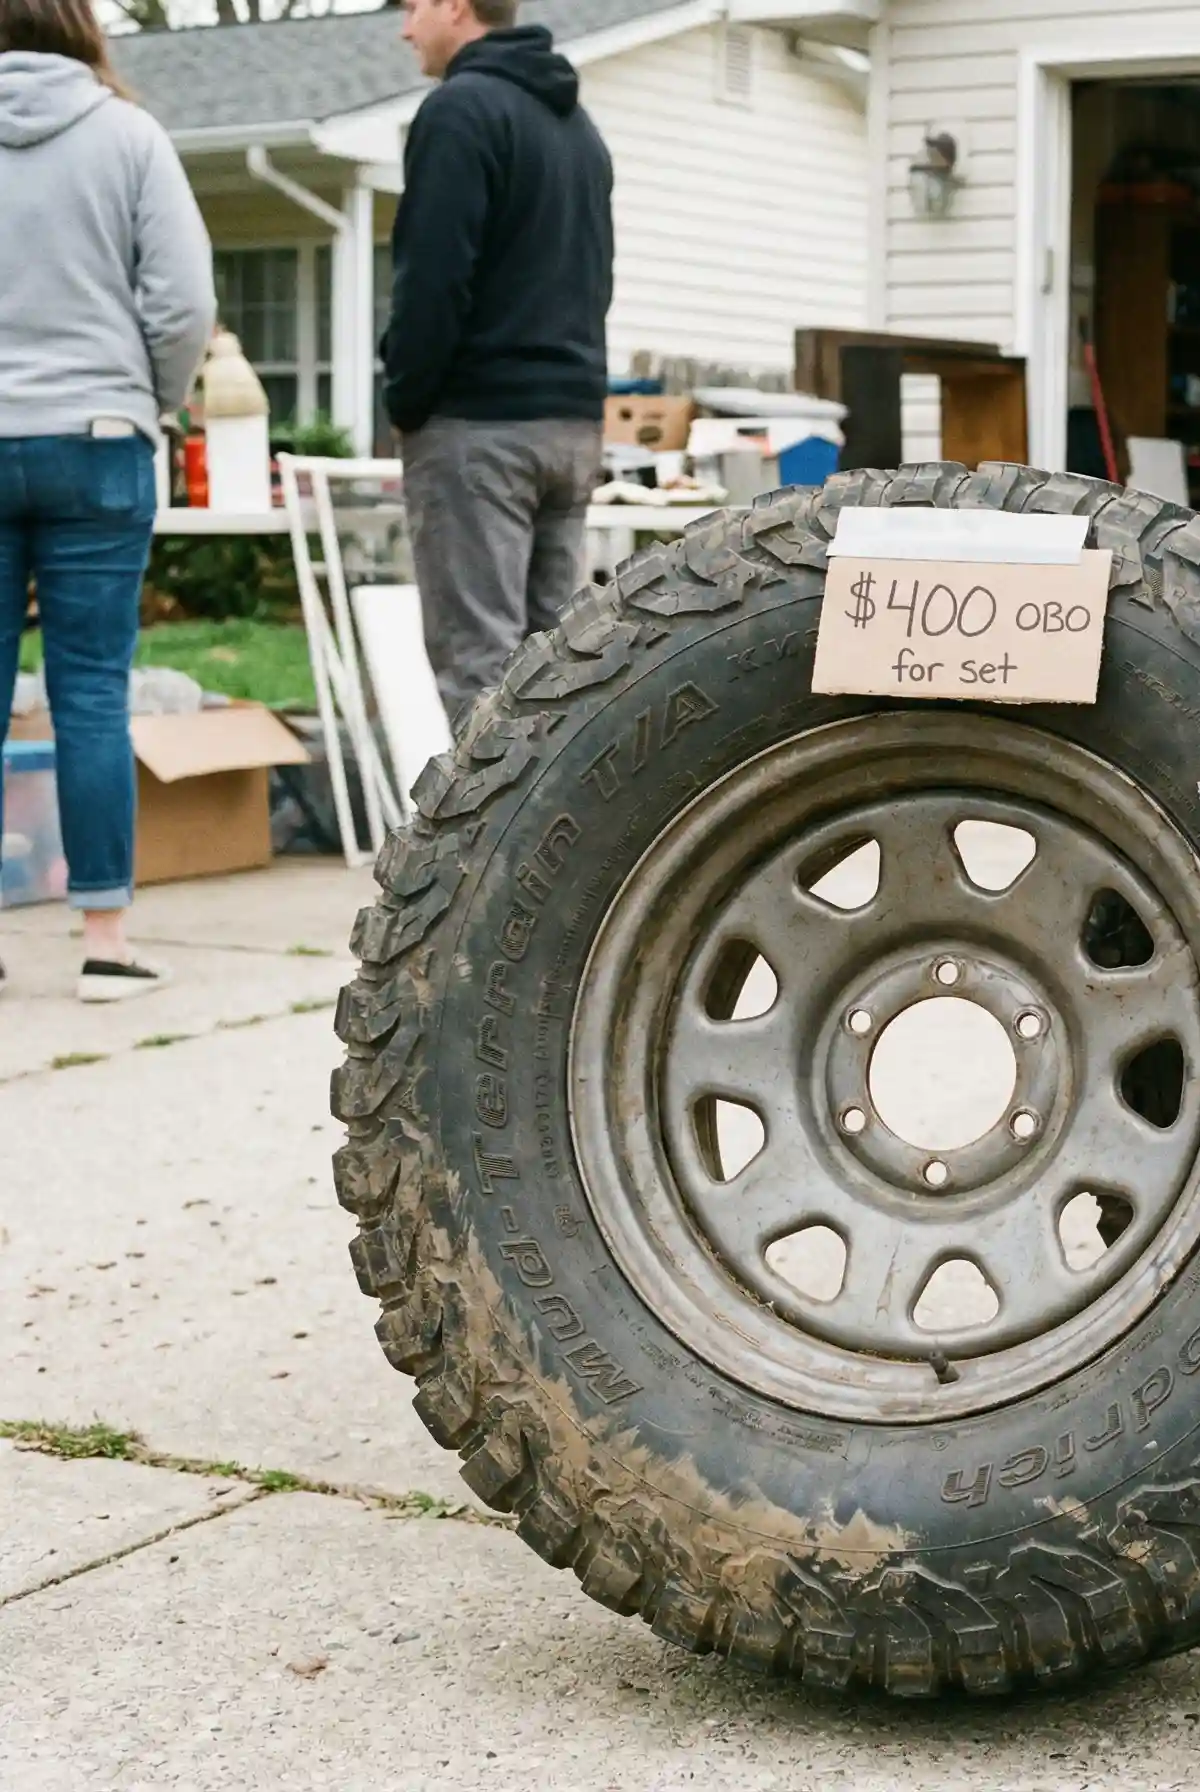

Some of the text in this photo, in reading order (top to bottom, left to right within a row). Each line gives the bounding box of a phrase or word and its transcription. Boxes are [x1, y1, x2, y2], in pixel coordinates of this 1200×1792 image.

[844, 571, 1091, 638] $400 OBO
[891, 647, 1018, 684] for set
[471, 813, 645, 1404] Mud-Terrain
[578, 680, 720, 800] T/A
